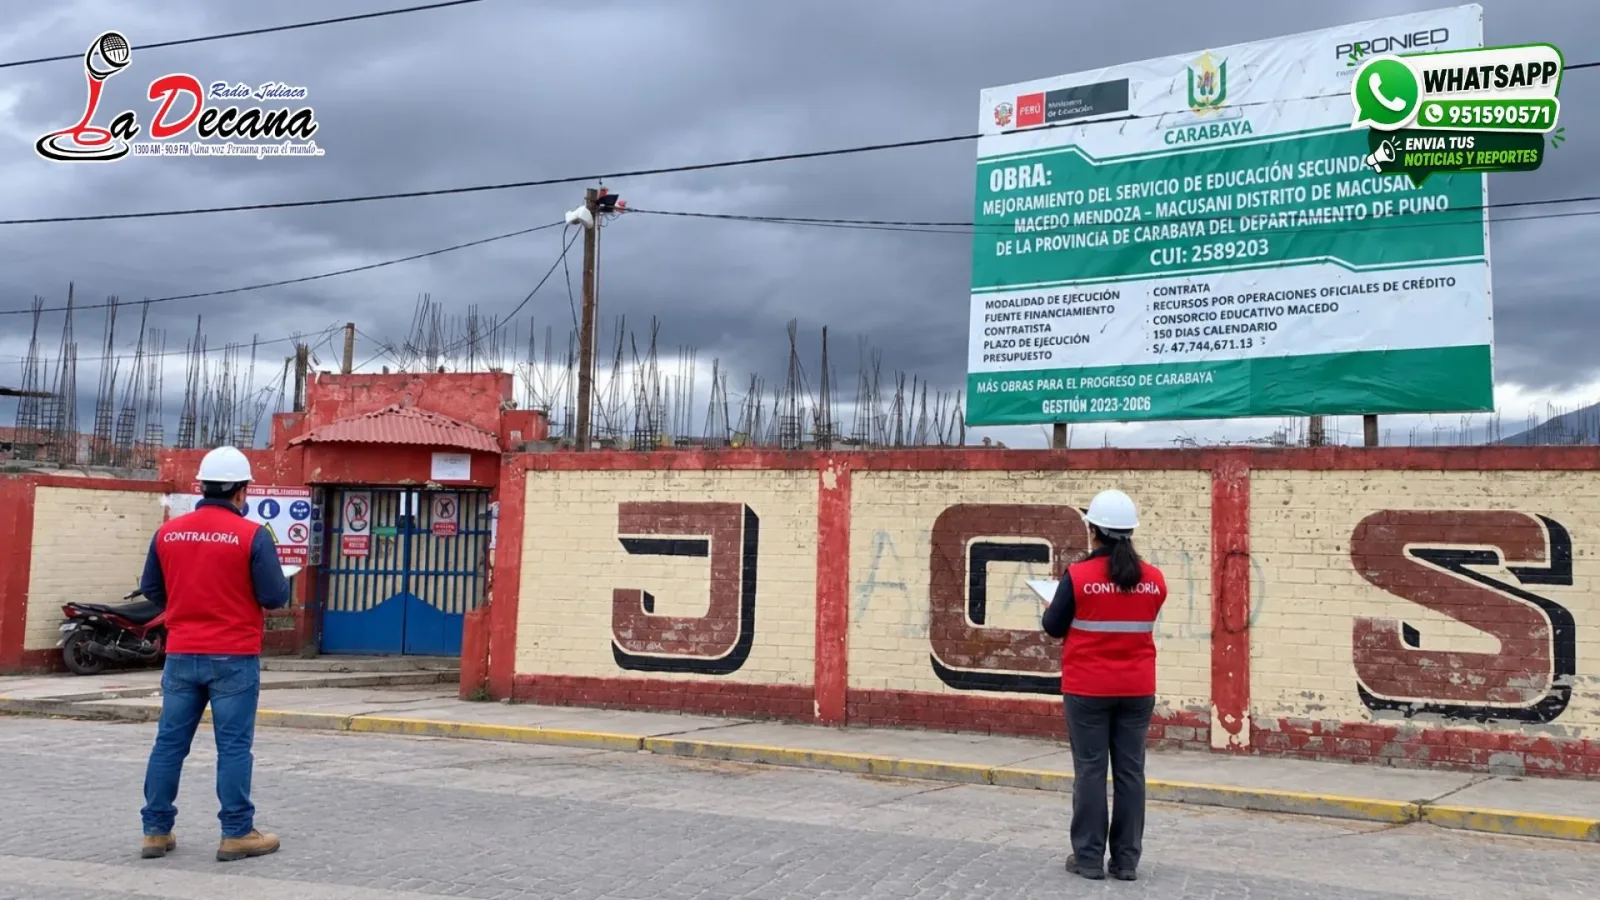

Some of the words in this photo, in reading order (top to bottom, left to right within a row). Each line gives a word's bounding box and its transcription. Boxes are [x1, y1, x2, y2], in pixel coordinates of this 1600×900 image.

[1336, 28, 1449, 59] PRONIED
[1019, 104, 1041, 116] PERÚ
[1164, 119, 1253, 145] CARABAYA
[983, 190, 1085, 217] MEJORAMIENTO
[1088, 187, 1112, 204] DEL
[1116, 178, 1180, 200] SERVICIO
[1184, 175, 1202, 192] DE
[1206, 160, 1293, 190] EDUCACIÓN
[1298, 154, 1374, 178] SECUNDA
[990, 163, 1052, 192] OBRA:
[1014, 213, 1070, 234] MACEDO
[1073, 205, 1141, 227] MENDOZA
[1155, 194, 1232, 218] MACUSANI
[1236, 185, 1306, 209] DISTRITO
[1311, 183, 1332, 201] DE
[1336, 174, 1424, 198] MACUSAN
[996, 240, 1012, 256] DE
[1015, 239, 1032, 254] LA
[1112, 228, 1130, 245] DE
[1134, 220, 1206, 242] CARABAYA
[1209, 218, 1235, 235] DEL
[1240, 203, 1367, 232] DEPARTAMENTO
[1372, 200, 1394, 218] DE
[1399, 194, 1449, 216] PUNO
[1150, 246, 1187, 266] CUI:
[1191, 238, 1269, 262] 2589203
[985, 296, 1045, 309] MODALIDAD
[1047, 295, 1060, 305] DE
[1062, 289, 1120, 305] EJECUCIÓN
[1153, 283, 1211, 297] CONTRATA
[1153, 297, 1209, 311] RECURSOS
[1211, 295, 1235, 307] POR
[1237, 288, 1317, 304] OPERACIONES
[1320, 283, 1380, 297] OFICIALES
[1383, 281, 1399, 292] DE
[1402, 276, 1456, 290] CRÉDITO
[984, 311, 1022, 323] FUENTE
[1024, 305, 1115, 320] FINANCIAMIENTO
[1153, 312, 1218, 325] CONSORCIO
[1220, 306, 1284, 320] EDUCATIVO
[1287, 302, 1339, 315] MACEDO
[984, 323, 1052, 336] CONTRATISTA
[1153, 329, 1172, 339] 150
[1175, 327, 1200, 338] DIAS
[1203, 321, 1278, 335] CALENDARIO
[983, 339, 1016, 350] PLAZO
[1018, 337, 1031, 348] DE
[1034, 333, 1090, 348] EJECUCIÓN
[1170, 338, 1253, 353] 47,744,671.13
[983, 351, 1053, 363] PRESUPUESTO
[976, 378, 998, 393] MÁS
[1000, 377, 1034, 392] OBRAS
[1037, 376, 1063, 390] PARA
[1066, 376, 1078, 389] EL
[1080, 374, 1136, 388] PROGRESO
[1138, 374, 1152, 386] DE
[1042, 394, 1087, 414] GESTIÓN
[163, 531, 240, 545] CONTRALORÍA
[611, 501, 760, 675] J
[1350, 509, 1576, 724] S
